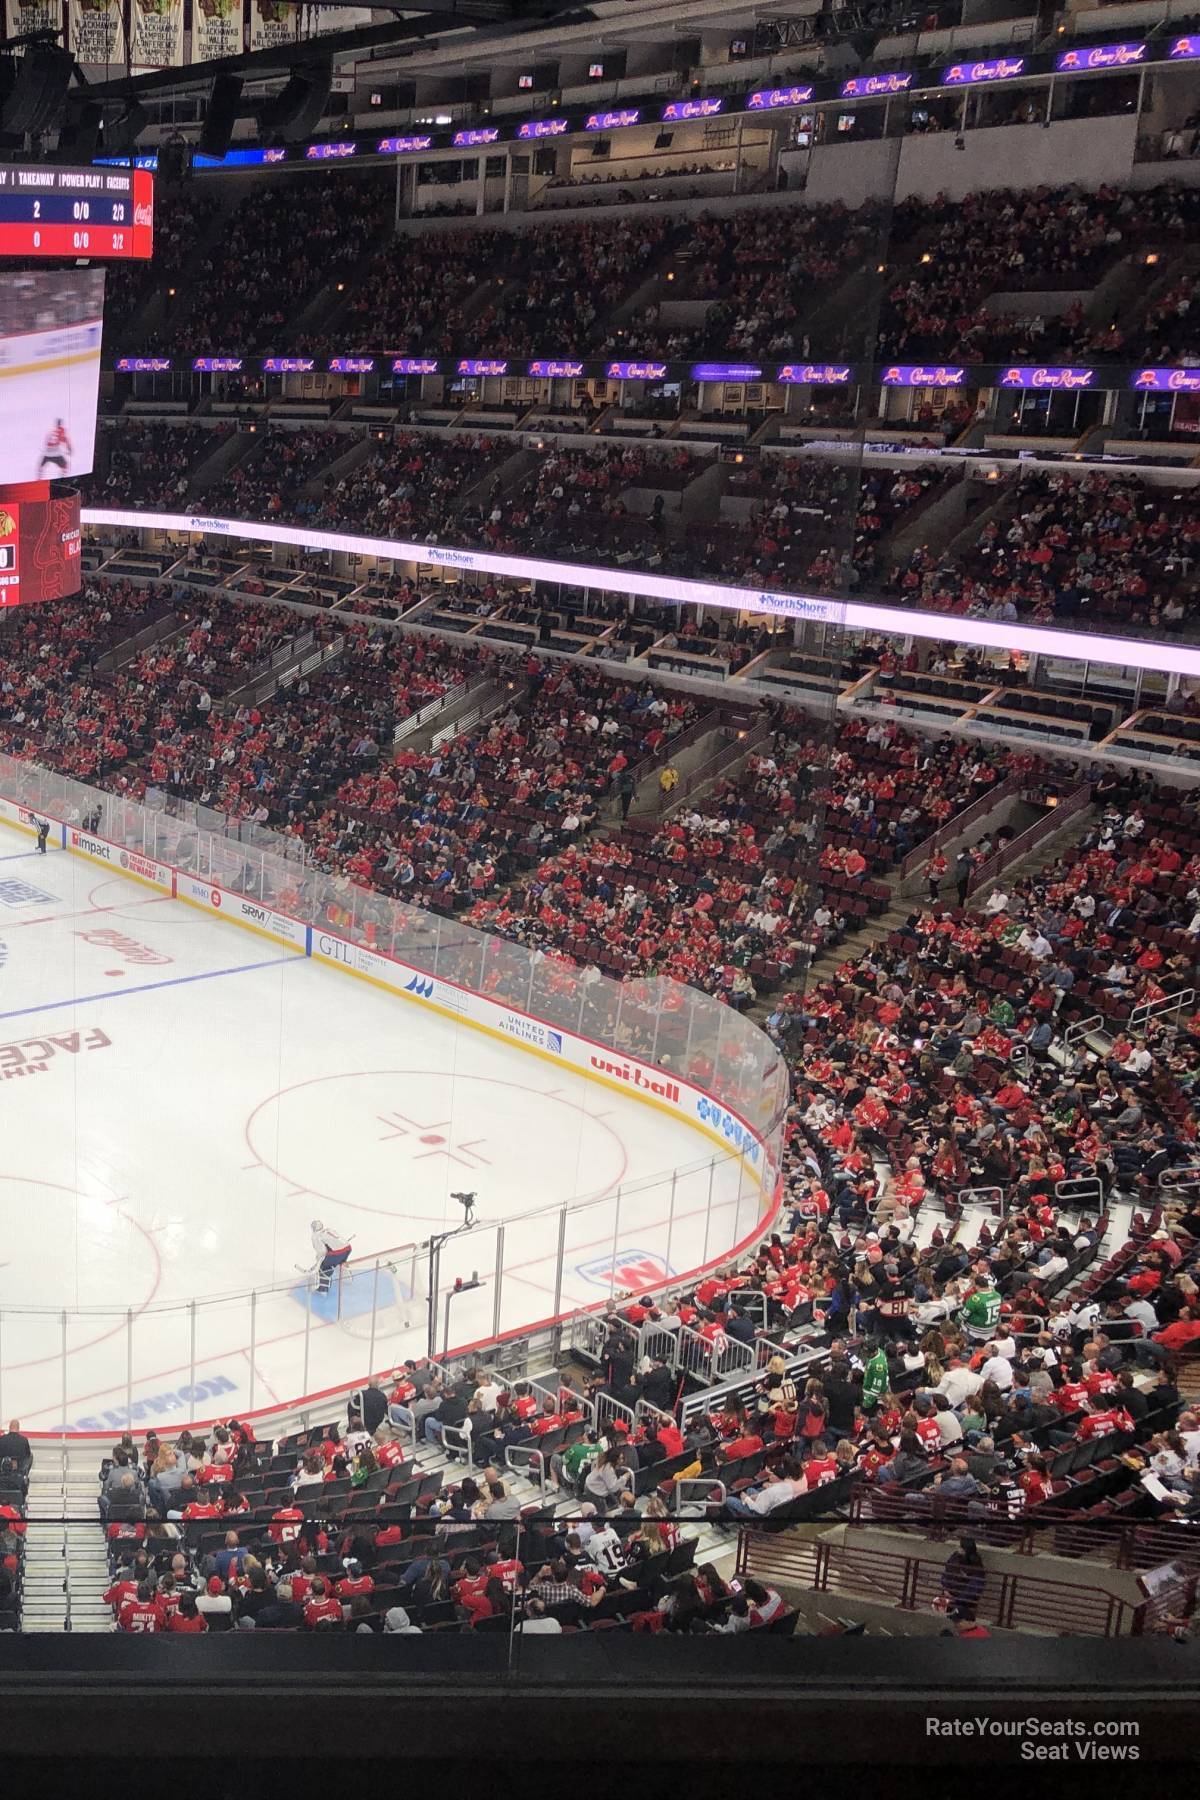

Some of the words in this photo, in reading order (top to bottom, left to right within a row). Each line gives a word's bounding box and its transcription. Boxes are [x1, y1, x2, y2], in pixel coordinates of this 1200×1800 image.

[1087, 49, 1118, 66] Crown
[1113, 45, 1146, 63] Royal
[971, 63, 999, 80] Crown
[994, 59, 1025, 77] Royal
[865, 77, 889, 93] Crown
[886, 74, 912, 91] Royal
[769, 90, 792, 106] Crown
[788, 87, 813, 105] Royal
[18, 172, 55, 186] TAKEAWAY
[61, 174, 84, 187] POWER
[85, 175, 101, 188] PLAY
[33, 201, 41, 218] 2
[73, 201, 90, 220] 0/0
[112, 203, 125, 221] 2/3
[33, 231, 41, 248] 0
[73, 232, 89, 248] 0/0
[112, 233, 124, 250] 3/2
[802, 366, 827, 380] Crown
[823, 367, 848, 383] Royal
[910, 370, 936, 384] Crown
[933, 370, 965, 385] Royal
[1032, 370, 1060, 386] Crown
[1054, 371, 1090, 387] Royal
[194, 519, 230, 530] NorthShore
[432, 550, 474, 564] NorthShore
[0, 589, 7, 604] 1
[766, 595, 828, 613] NorthShore
[78, 833, 111, 860] impact
[128, 864, 156, 880] REWARDS
[191, 884, 209, 900] BMO
[241, 903, 266, 922] SRM
[319, 935, 351, 964] GTL
[498, 1021, 545, 1046] AIRLINES
[507, 1015, 545, 1037] UNITED
[891, 1302, 905, 1315] 81
[986, 1308, 1000, 1326] 15
[782, 1382, 796, 1399] 10
[602, 1546, 627, 1570] 19
[132, 1613, 156, 1621] MIKITA
